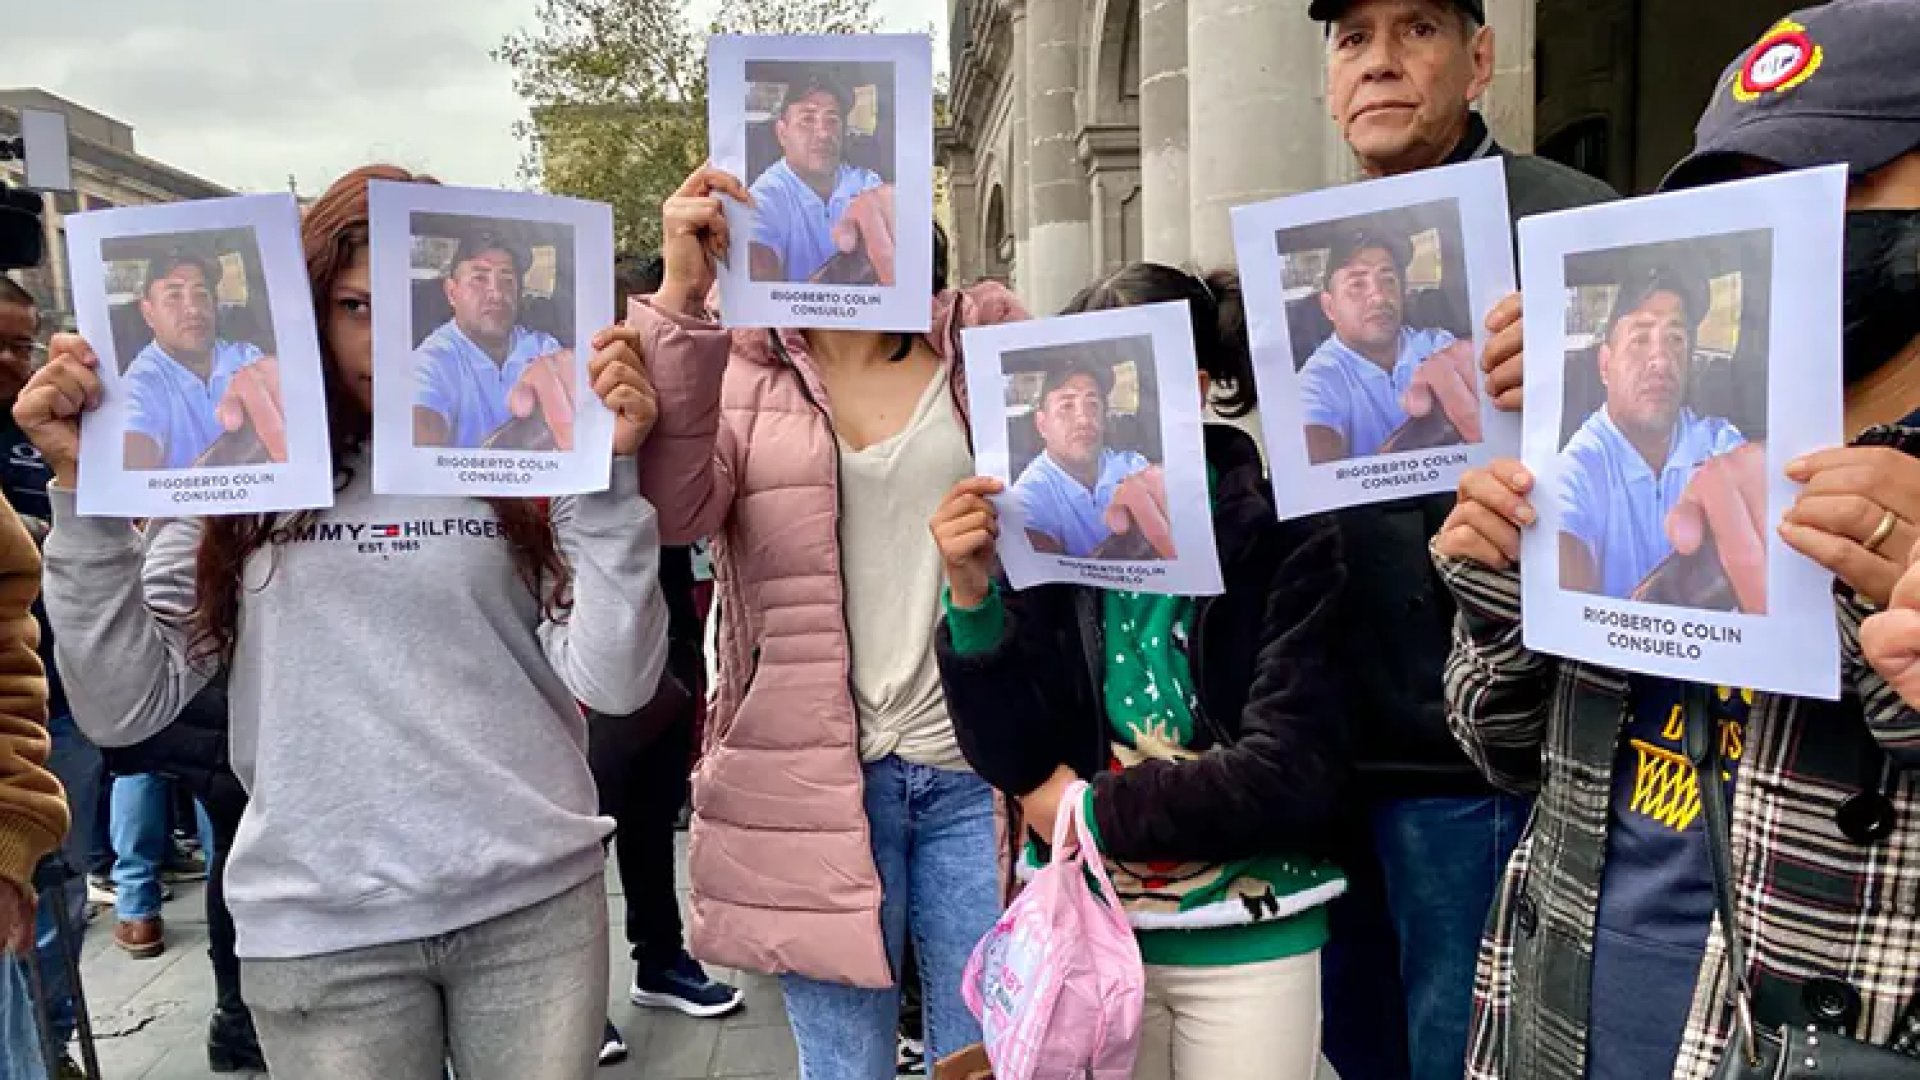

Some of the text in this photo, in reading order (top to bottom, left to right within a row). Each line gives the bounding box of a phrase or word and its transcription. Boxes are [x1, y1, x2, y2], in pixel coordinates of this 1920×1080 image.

[770, 290, 881, 305] RIGOBERTO COLIN
[791, 304, 858, 318] CONSUELO
[437, 455, 559, 470] RIGOBERTO COLIN
[1335, 452, 1468, 480] RIGOBERTO COLIN
[148, 473, 275, 489] RIGOBERTO COLIN
[458, 471, 532, 483] CONSUELO
[1361, 470, 1440, 490] CONSUELO
[171, 488, 249, 502] CONSUELO
[262, 523, 364, 545] OMMY
[1126, 566, 1165, 576] COLIN
[1584, 606, 1742, 643] RIGOBERTO COLIN
[1607, 632, 1701, 660] CONSUELO
